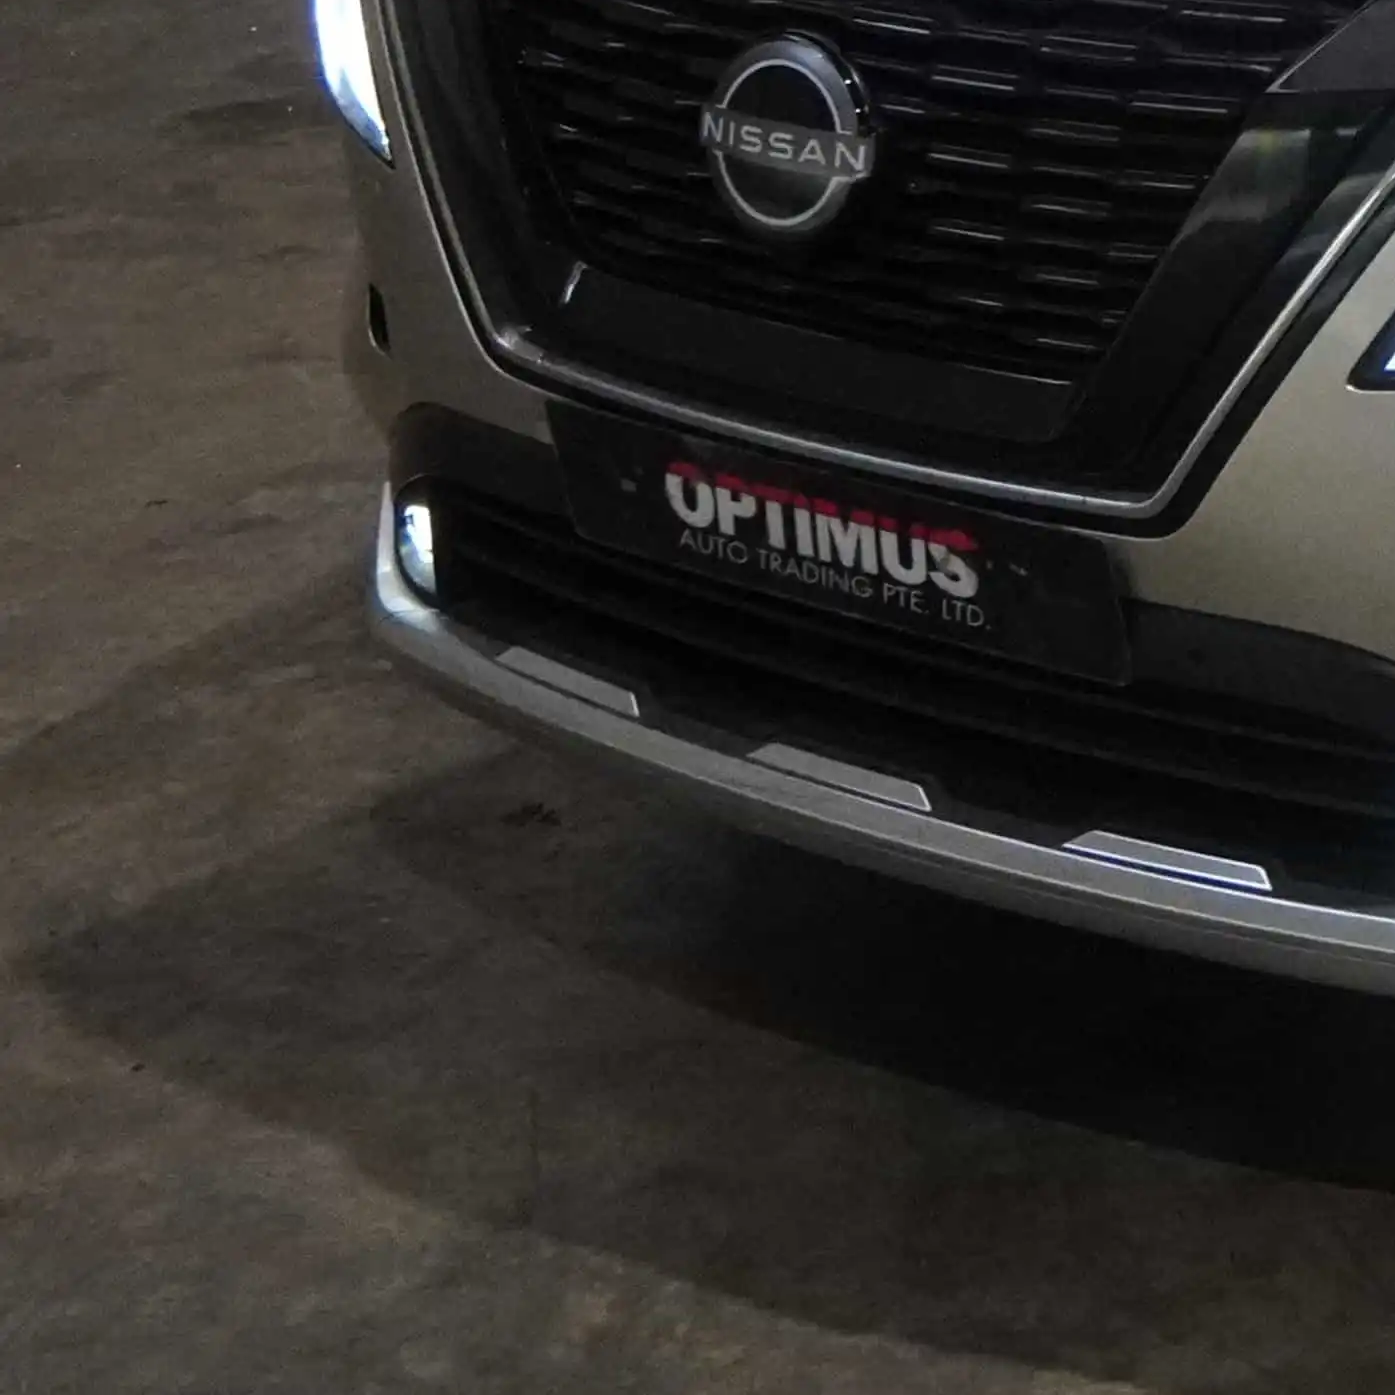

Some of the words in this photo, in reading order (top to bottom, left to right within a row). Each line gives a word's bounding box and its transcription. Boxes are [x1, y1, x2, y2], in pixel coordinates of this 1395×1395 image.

[702, 111, 868, 172] NISSAN
[664, 462, 980, 598] OPTIMUS
[679, 528, 749, 564] AUTO
[756, 547, 874, 598] TRADING
[882, 582, 930, 615] PTE.
[941, 598, 993, 632] LTD.
